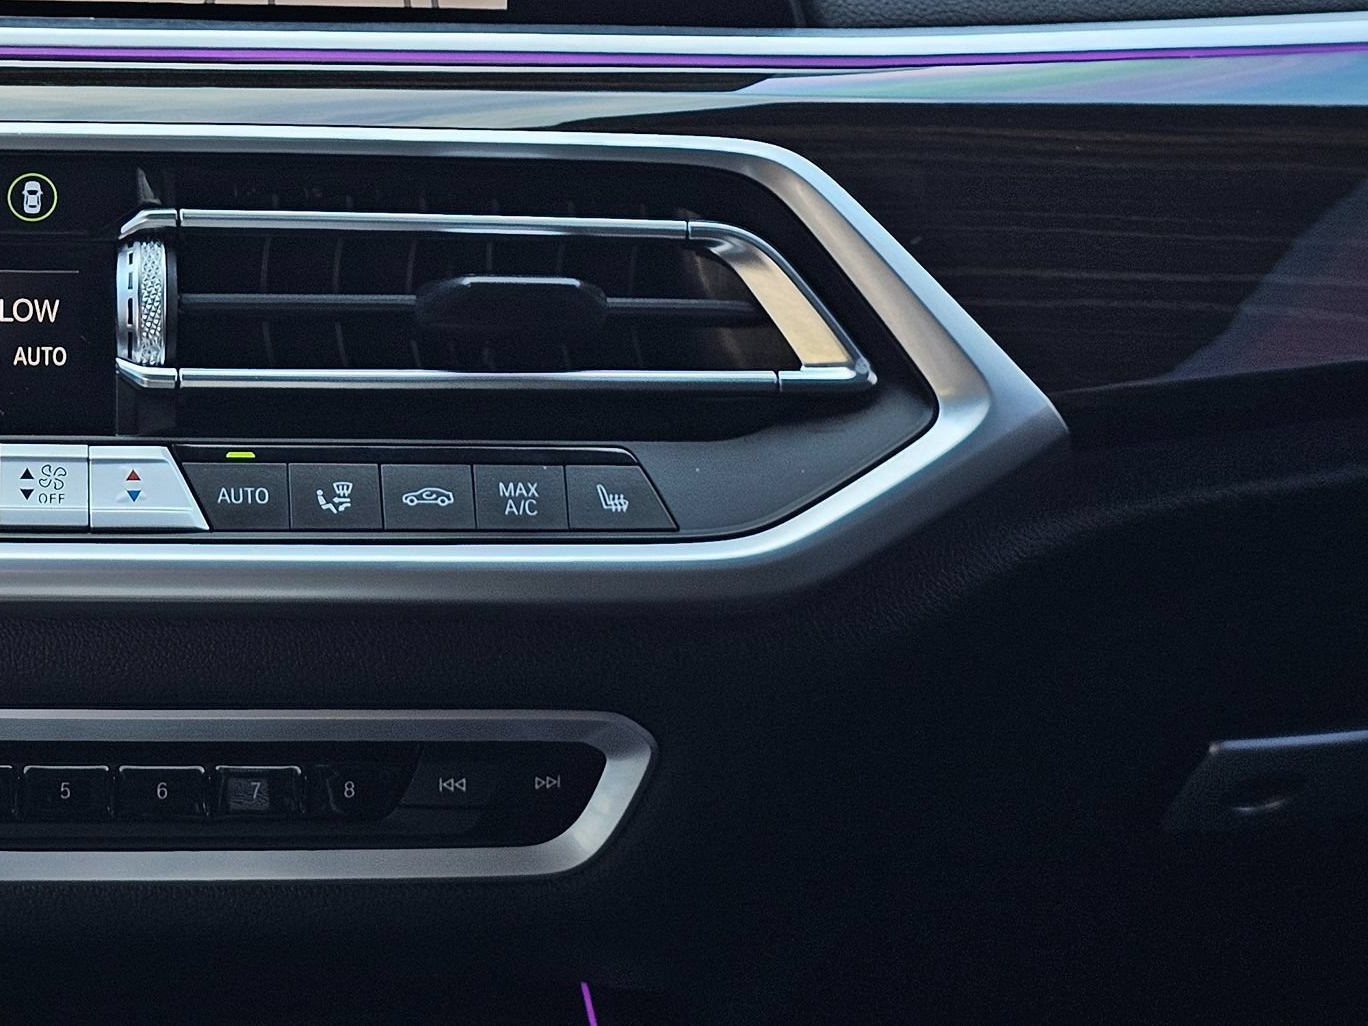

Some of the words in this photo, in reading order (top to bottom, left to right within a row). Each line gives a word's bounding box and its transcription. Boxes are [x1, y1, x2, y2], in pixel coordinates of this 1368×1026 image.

[13, 346, 67, 367] AUTO
[38, 492, 66, 505] OFF
[217, 487, 269, 505] AUTO
[499, 482, 539, 498] MAX
[505, 499, 538, 516] A/C
[60, 781, 71, 800] 5
[156, 781, 168, 800] 6
[250, 781, 261, 800] 7
[343, 780, 356, 799] 8
